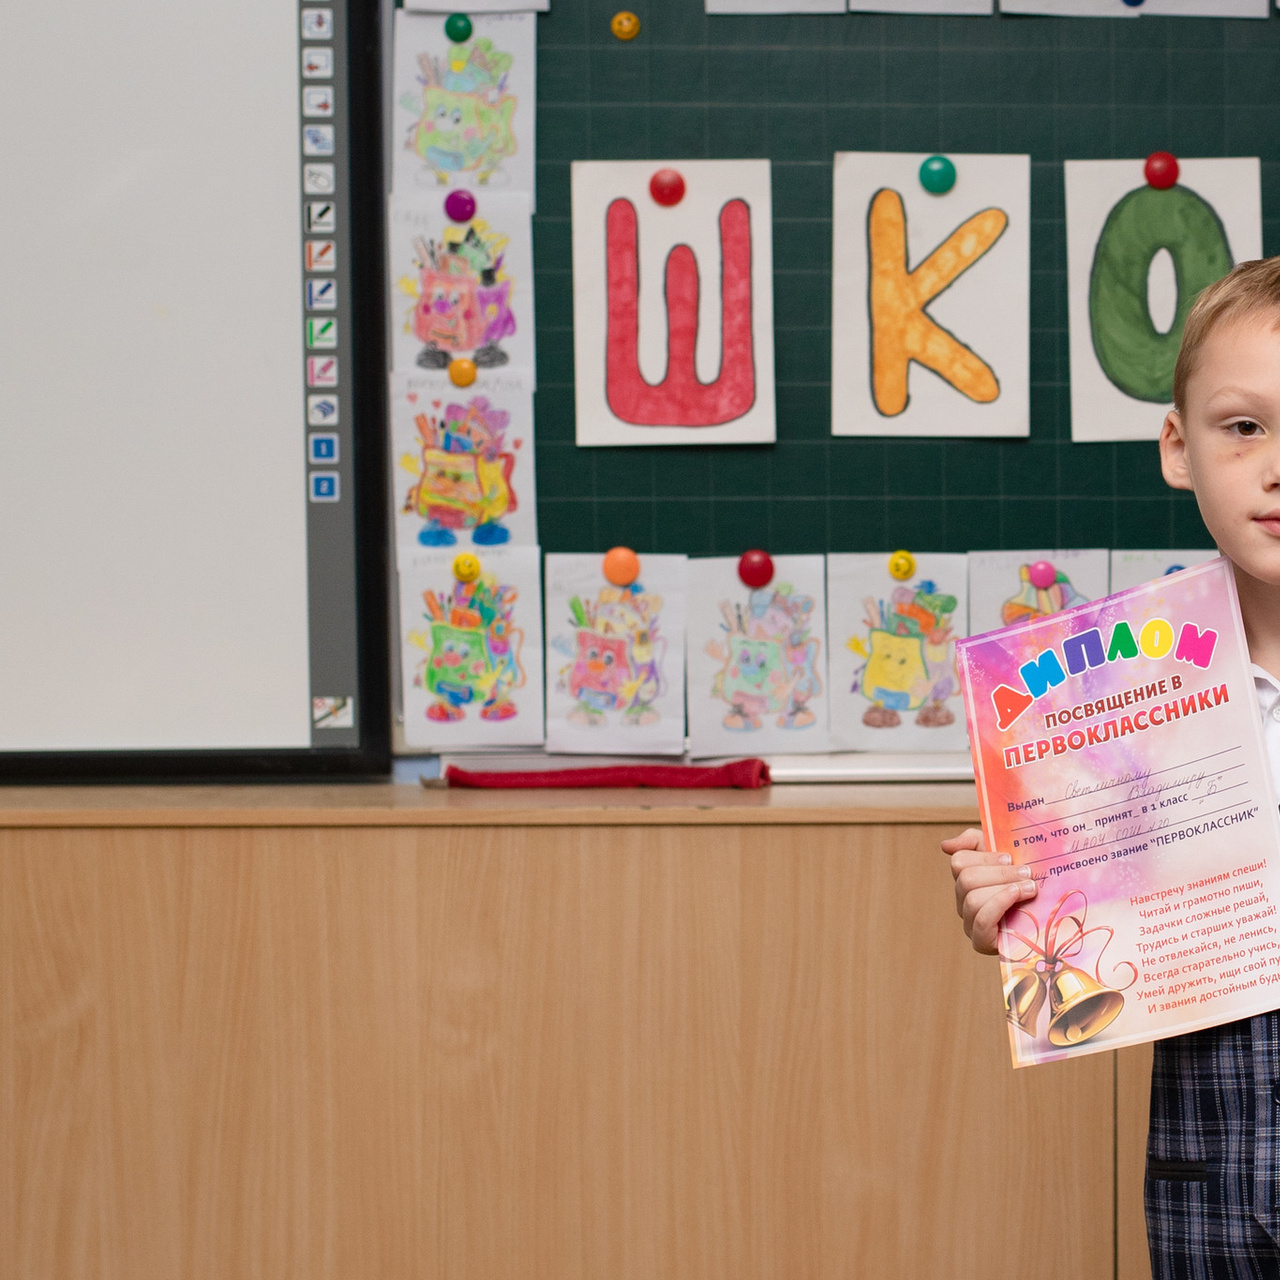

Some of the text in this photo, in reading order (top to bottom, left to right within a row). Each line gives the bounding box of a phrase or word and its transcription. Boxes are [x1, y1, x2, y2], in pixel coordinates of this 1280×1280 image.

[991, 618, 1218, 731] ДИПЛОМ
[1045, 674, 1183, 729] ПОСВЯЩЕНИЕ В
[1003, 683, 1230, 769] ПЕРВОКЛАССНИКИ
[1007, 797, 1045, 812] Выдан
[1013, 839, 1020, 848] в
[1023, 834, 1047, 845] том,
[1051, 828, 1069, 838] что
[1142, 805, 1148, 814] в
[1151, 803, 1157, 811] 1
[1159, 793, 1189, 809] класс
[1049, 854, 1108, 876] присвоено
[1110, 842, 1149, 859] звание
[1130, 858, 1267, 906] Навстречу знаниям спеши!
[1139, 879, 1263, 919] Читай и грамотно пиши,
[1136, 905, 1277, 954] Трудись и старших уважай!
[1139, 891, 1269, 936] Задачки сложные решай,
[1142, 925, 1277, 967] Не отвлекайся, не ленись,
[1144, 941, 1280, 983] Всегда старательно учись,
[1136, 986, 1165, 1001] Умей
[1168, 975, 1217, 995] дружить,
[1219, 969, 1241, 980] ищи
[1244, 959, 1267, 973] свой
[1148, 1004, 1157, 1014] И
[1159, 996, 1197, 1011] звания
[1200, 980, 1257, 1003] достойным
